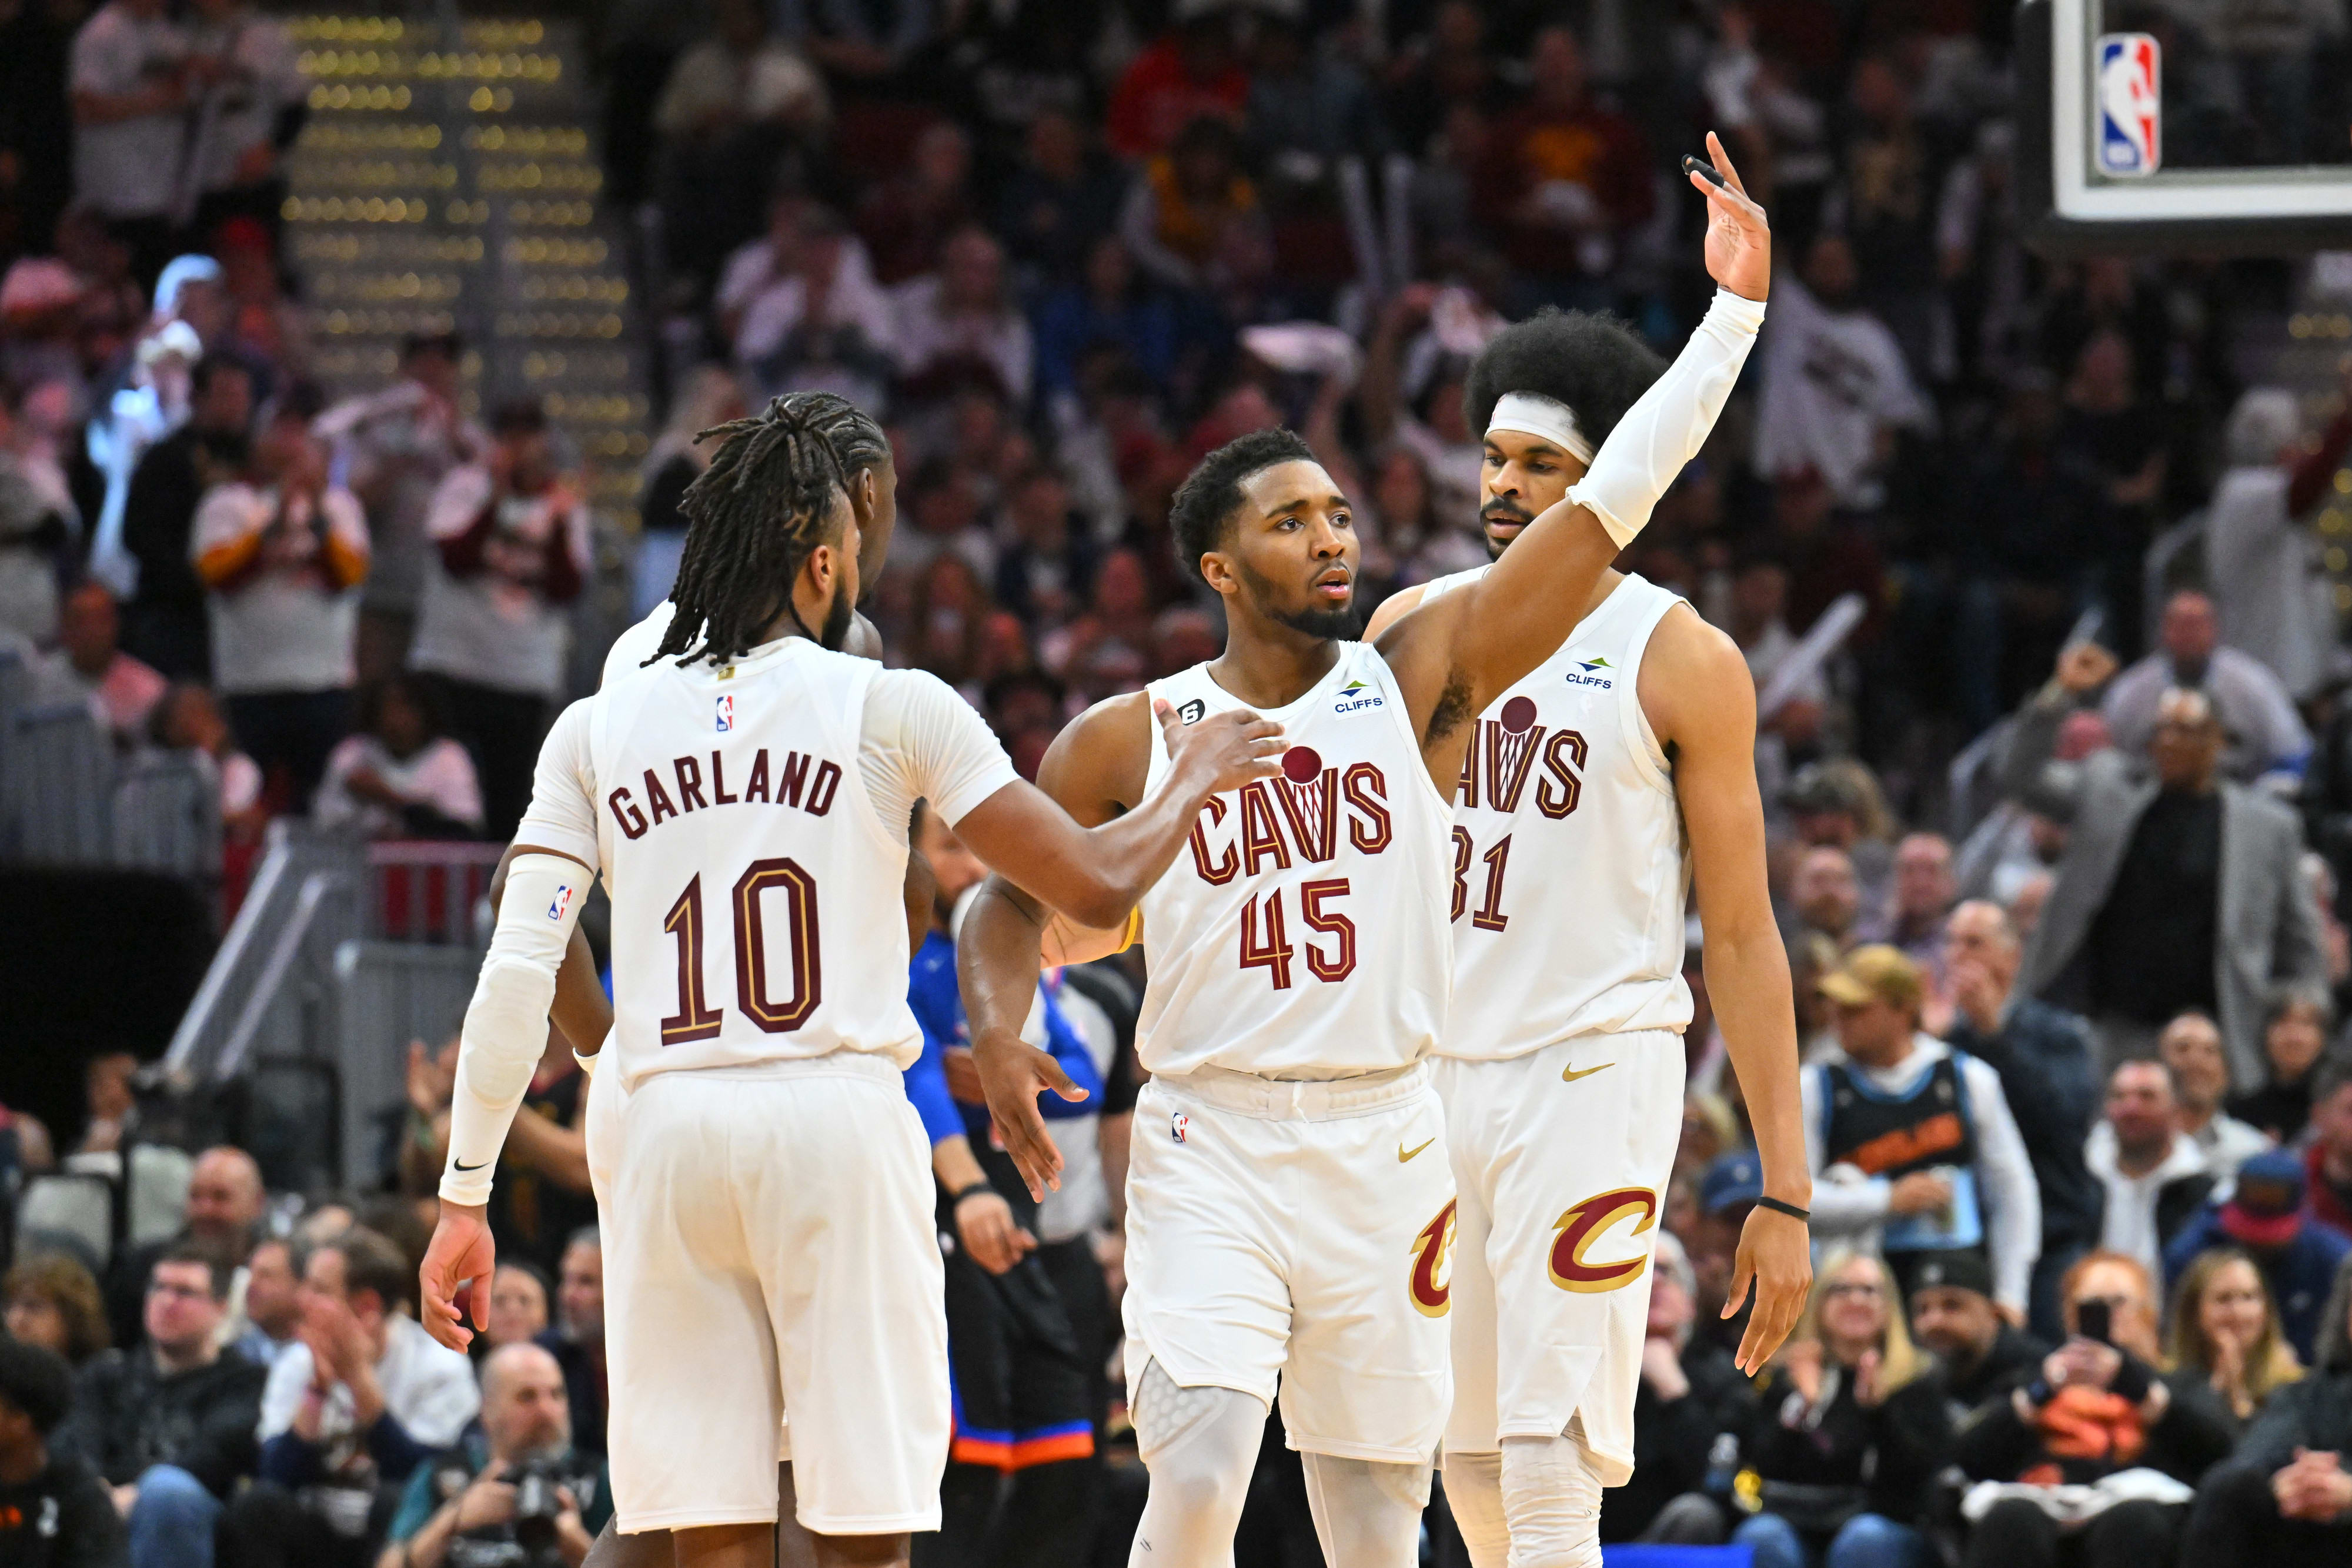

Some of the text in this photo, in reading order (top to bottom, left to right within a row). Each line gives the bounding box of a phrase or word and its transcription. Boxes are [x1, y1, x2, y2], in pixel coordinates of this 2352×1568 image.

[1182, 703, 1199, 724] 6
[1335, 698, 1383, 713] CLIFFS
[1565, 673, 1612, 689] CLIFFS
[608, 748, 843, 840] GARLAND
[1189, 761, 1392, 886] CAVS
[661, 857, 822, 1047] 10
[1240, 878, 1357, 990] 45
[1547, 1186, 1656, 1293] C
